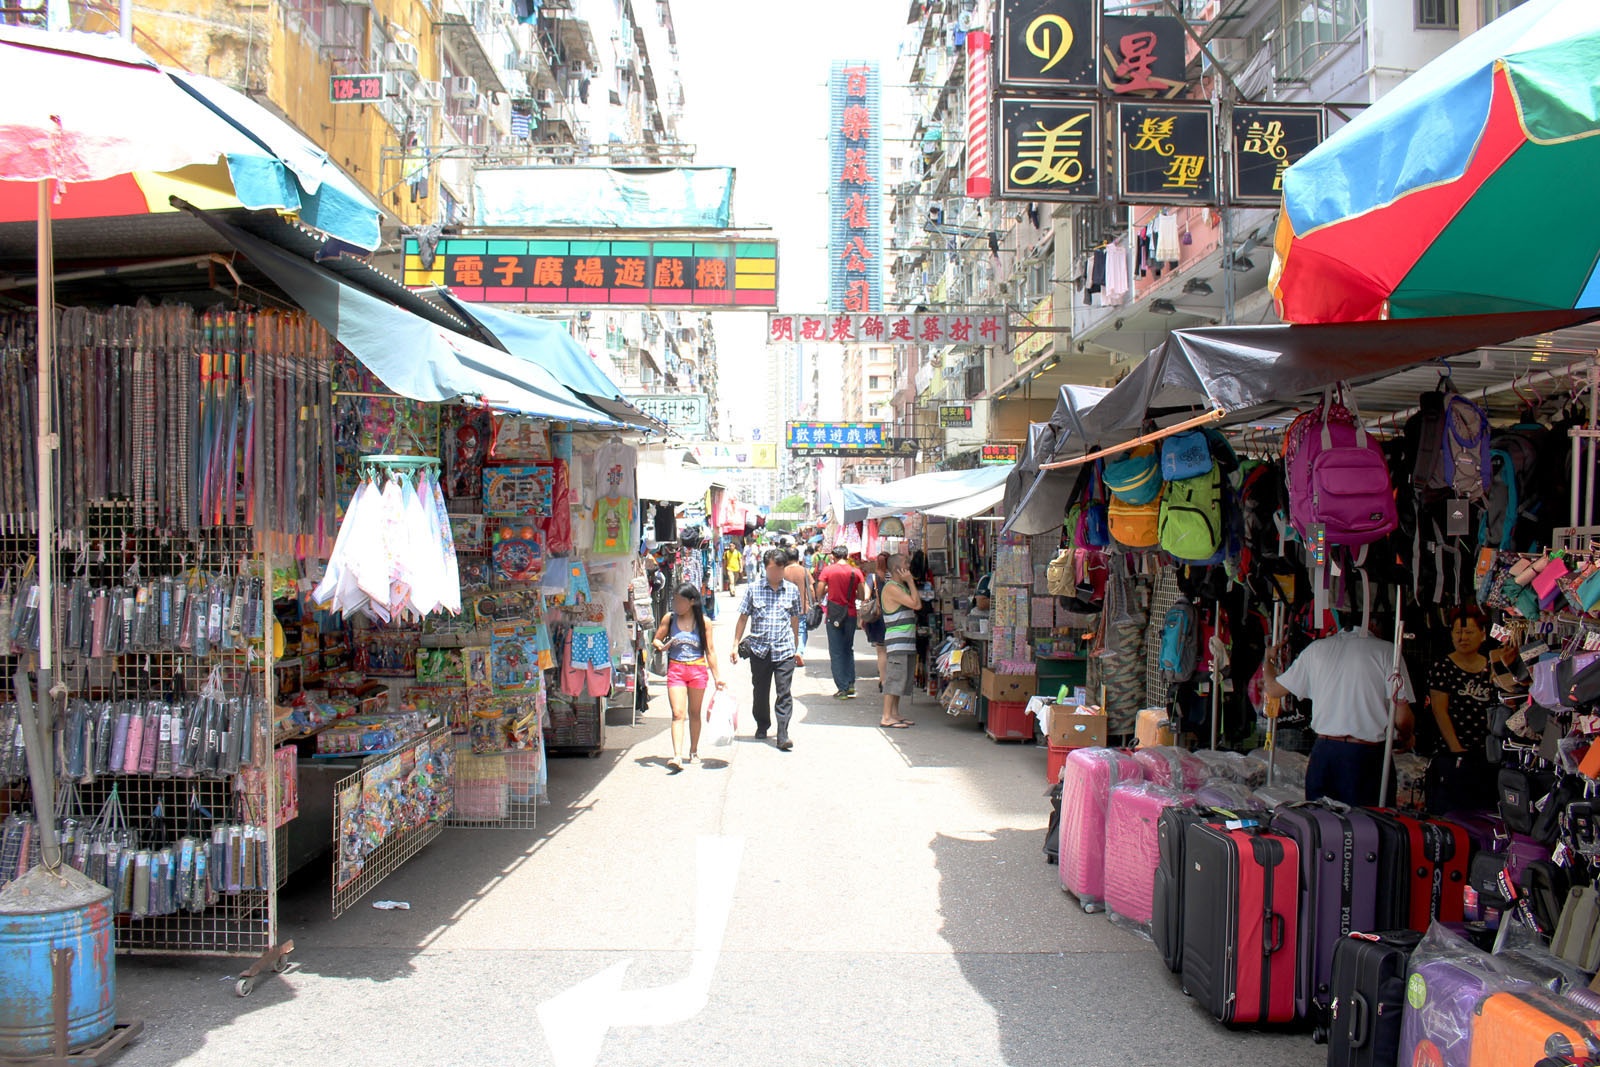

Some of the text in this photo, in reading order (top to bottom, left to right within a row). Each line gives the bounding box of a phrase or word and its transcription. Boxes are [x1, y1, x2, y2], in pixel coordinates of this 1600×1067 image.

[1010, 113, 1090, 185] 美
[1129, 116, 1205, 188] 髮型
[453, 255, 727, 289] 電子廣場遊戲機
[1457, 678, 1491, 702] Like
[1343, 830, 1353, 860] POLO
[1340, 906, 1351, 935] POLO
